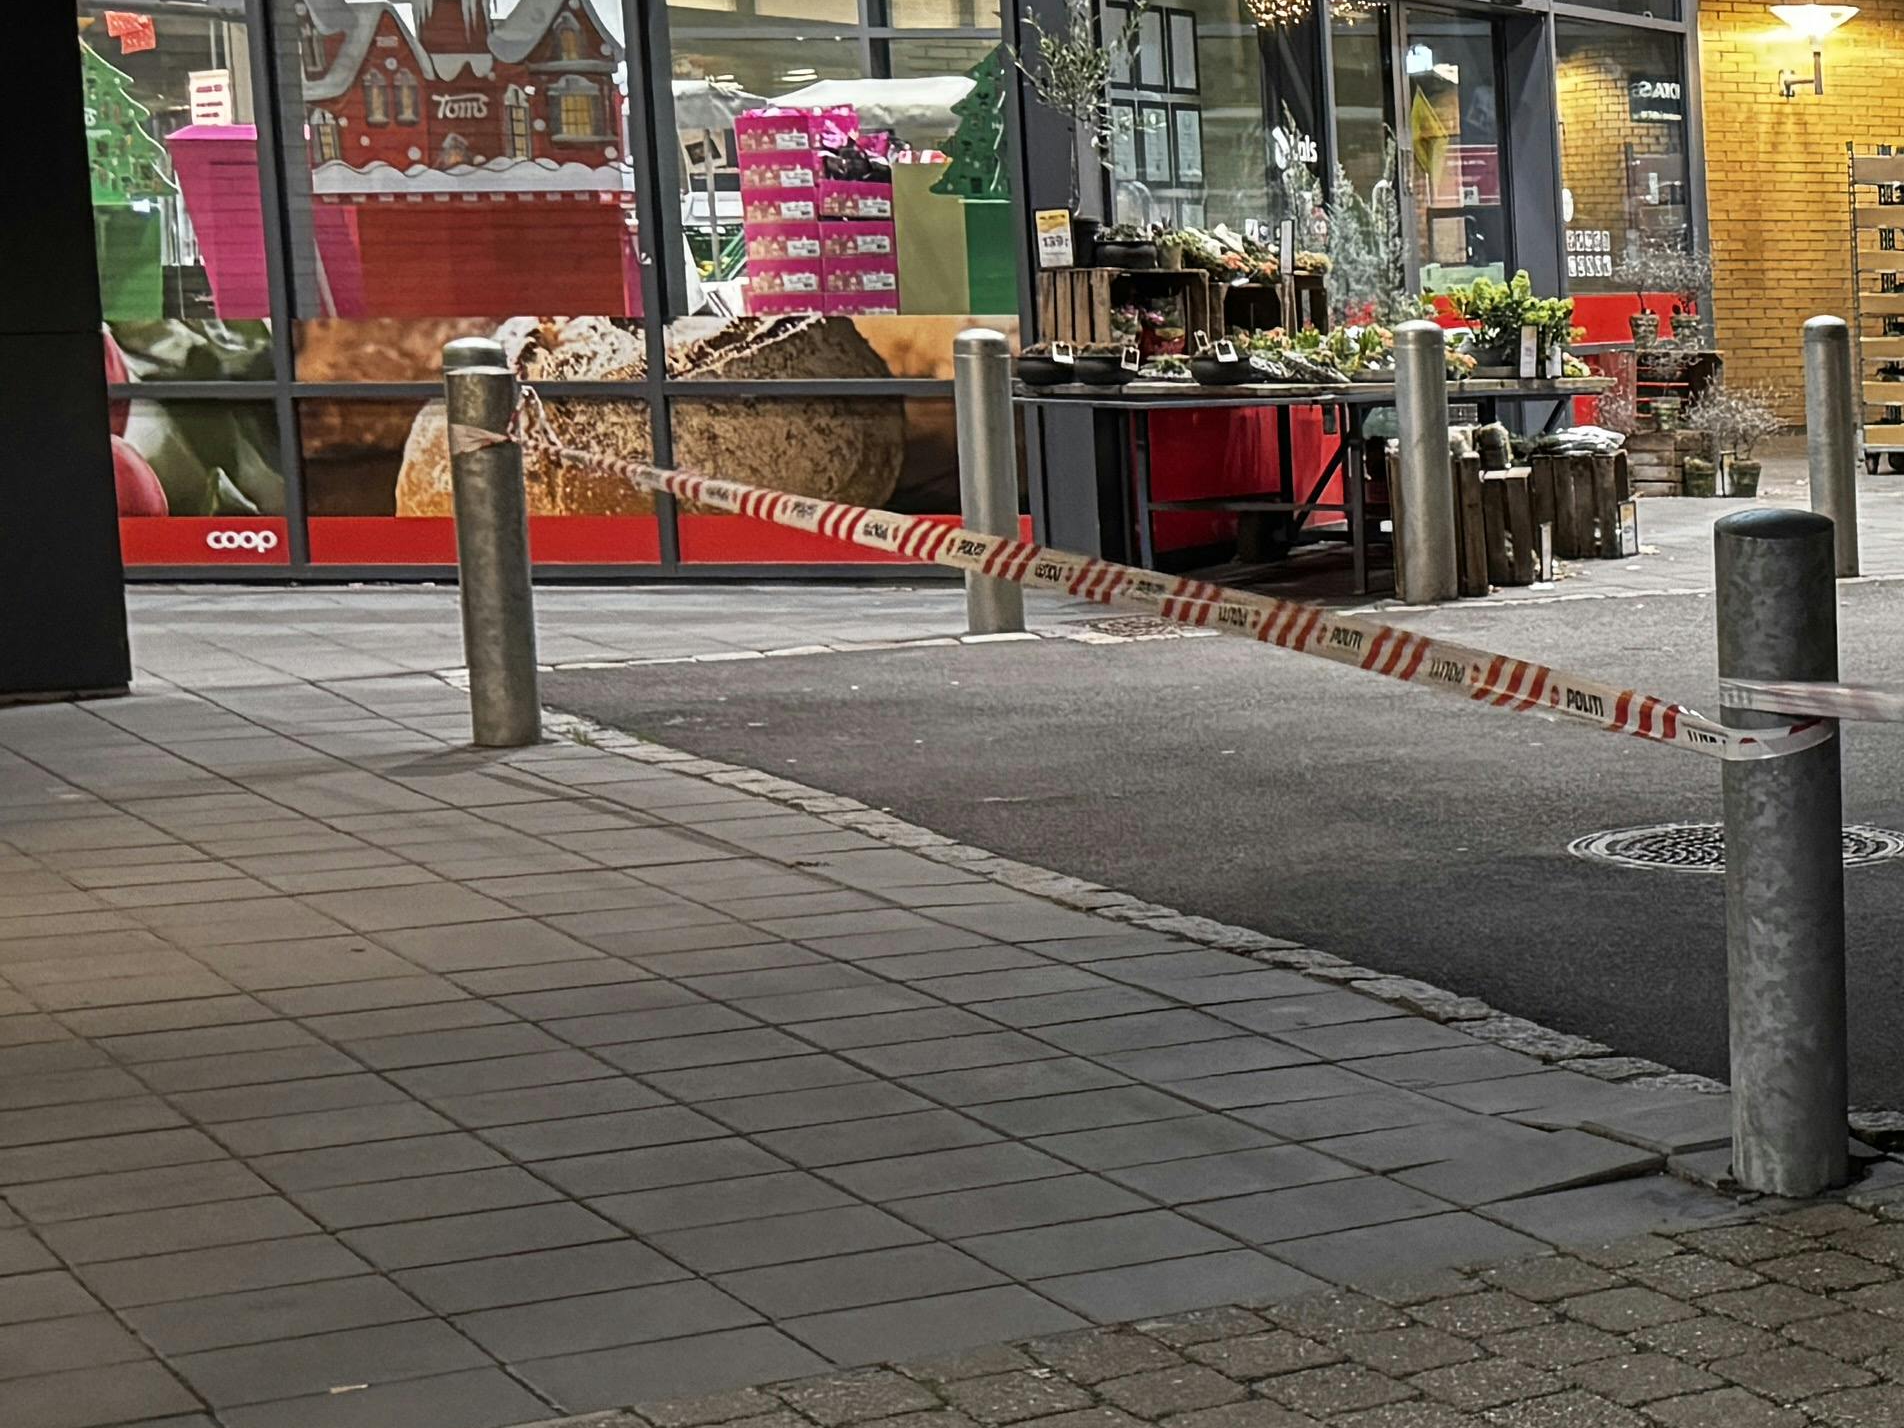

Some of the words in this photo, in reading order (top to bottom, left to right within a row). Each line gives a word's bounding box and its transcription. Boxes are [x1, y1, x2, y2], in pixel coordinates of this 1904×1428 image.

[431, 92, 490, 119] Toms
[206, 530, 278, 554] coop
[1329, 626, 1364, 651] POLITI
[1566, 687, 1605, 718] POLITI
